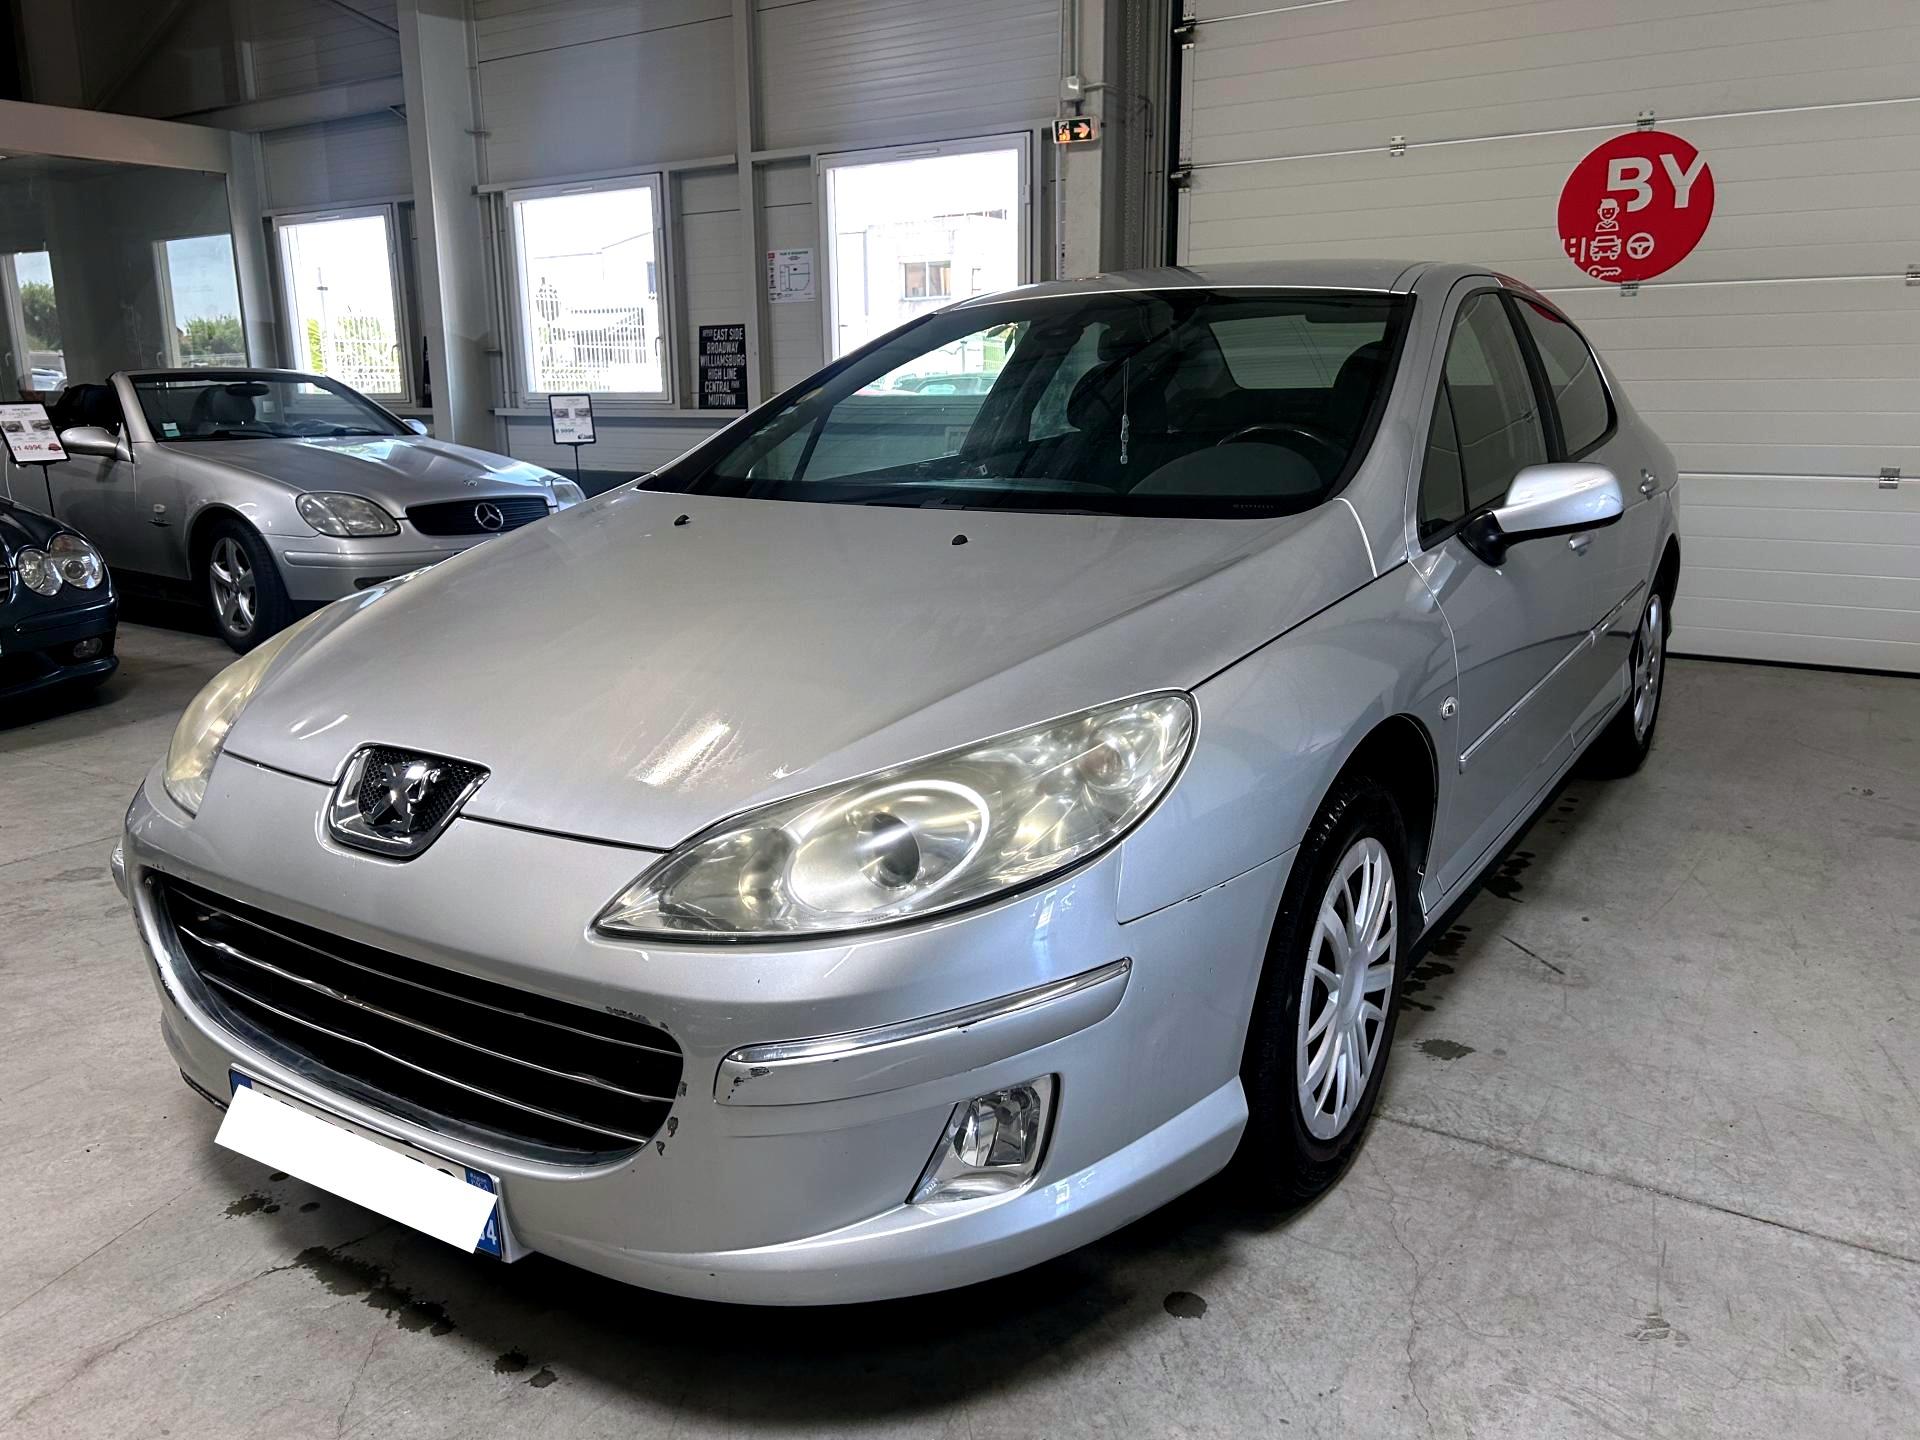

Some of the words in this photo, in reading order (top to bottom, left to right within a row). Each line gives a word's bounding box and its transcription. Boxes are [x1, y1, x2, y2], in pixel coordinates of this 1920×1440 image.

[1606, 152, 1706, 213] BY
[713, 328, 728, 340] EAST
[729, 328, 744, 340] SIDE
[706, 341, 739, 354] BROADWAY
[700, 353, 746, 367] WILLIAMSBURG
[707, 368, 722, 380] HIGH
[723, 367, 738, 380] LINE
[704, 380, 731, 393] CENTRAL
[708, 393, 737, 406] MIDTOWN
